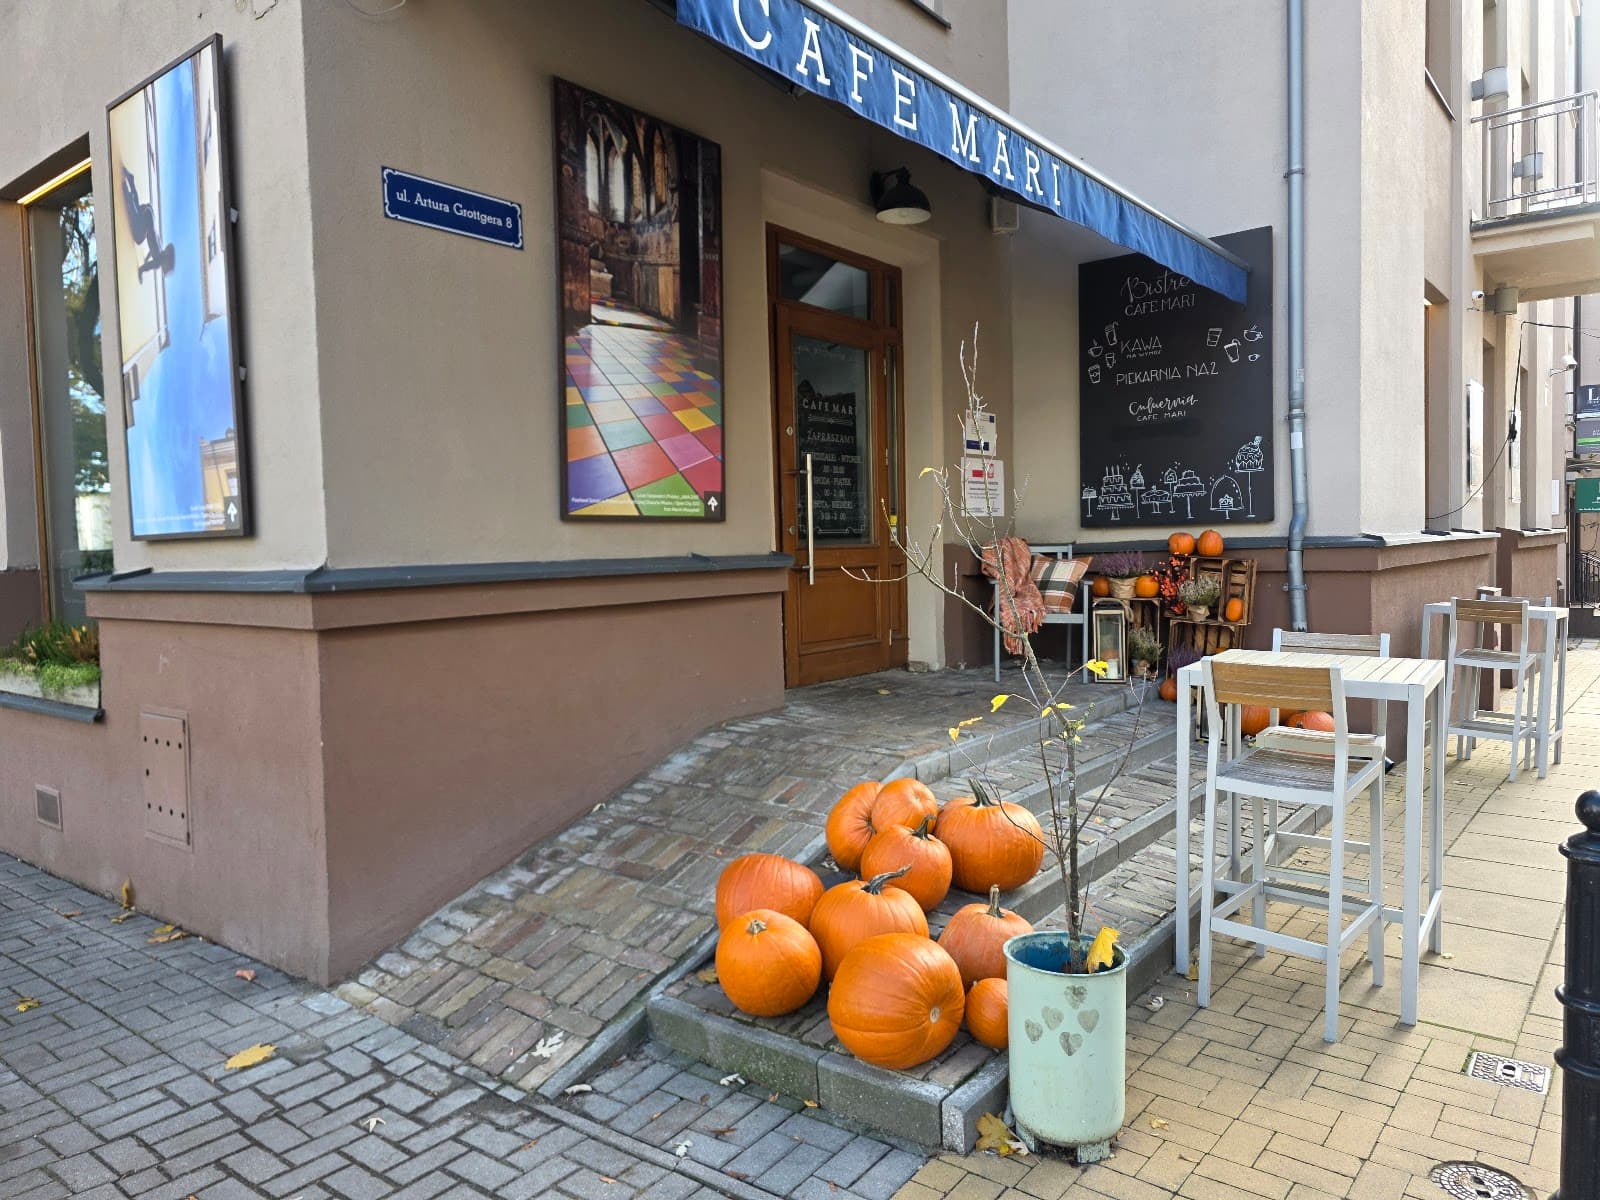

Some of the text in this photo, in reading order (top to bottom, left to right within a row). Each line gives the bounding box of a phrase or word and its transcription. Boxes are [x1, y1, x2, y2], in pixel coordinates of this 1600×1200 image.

[732, 0, 1061, 207] CAFE MARI
[396, 189, 513, 229] ul. Artura Grottgera 8
[1124, 294, 1197, 316] CAFE MARI
[1120, 336, 1162, 354] KAWA
[1116, 366, 1181, 385] PIEKARNIA
[802, 398, 829, 412] CAFE
[1136, 410, 1187, 422] CAFE MARI
[807, 430, 855, 444] ZAPRASZAMY
